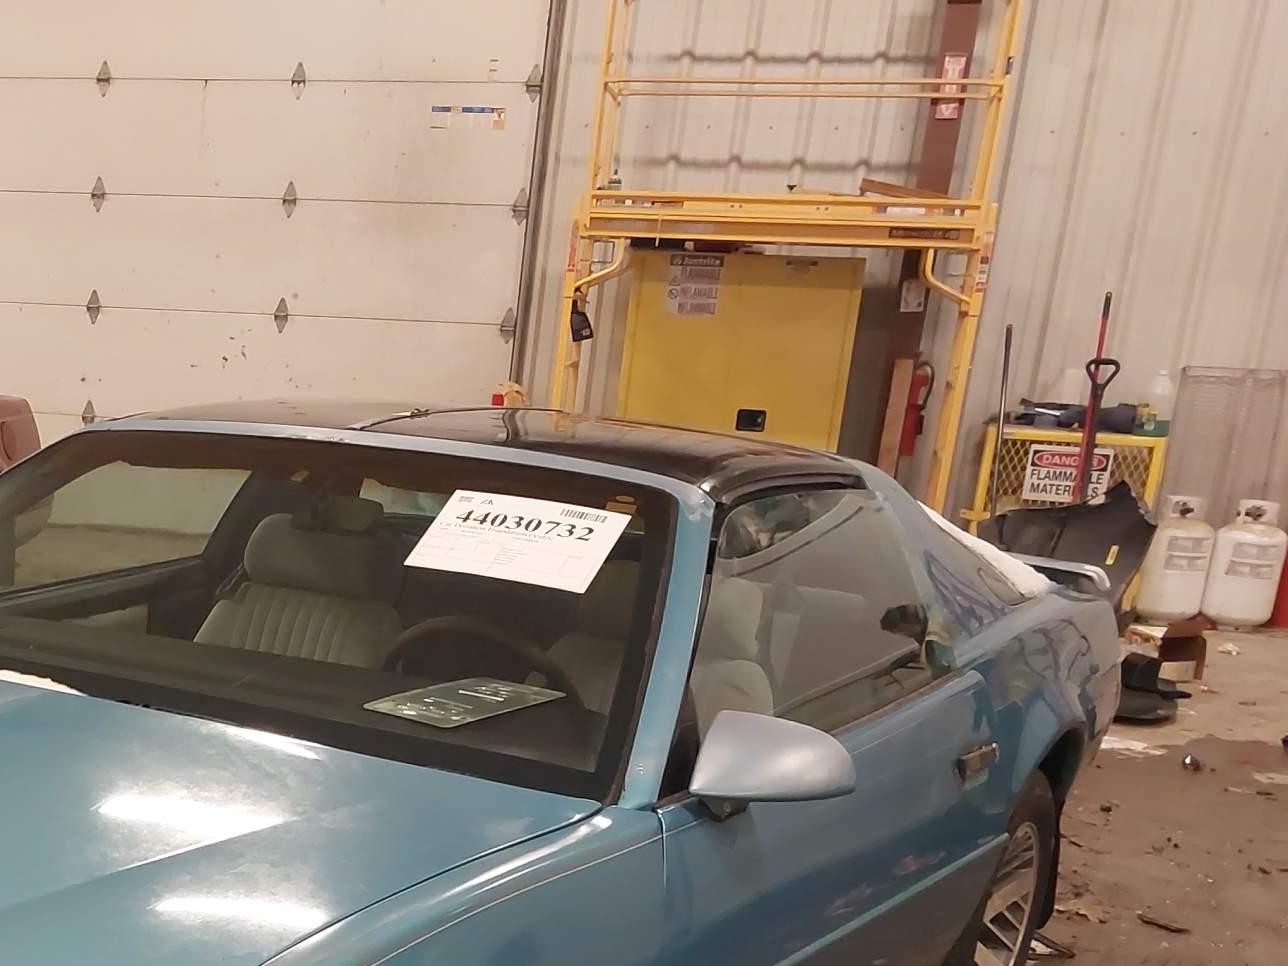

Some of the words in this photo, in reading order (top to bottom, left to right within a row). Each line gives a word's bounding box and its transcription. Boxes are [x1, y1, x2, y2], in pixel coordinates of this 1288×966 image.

[1042, 454, 1099, 467] DANGR
[1030, 468, 1105, 485] FLAMMLE
[1029, 482, 1099, 498] MATERS
[456, 509, 595, 542] 44030732
